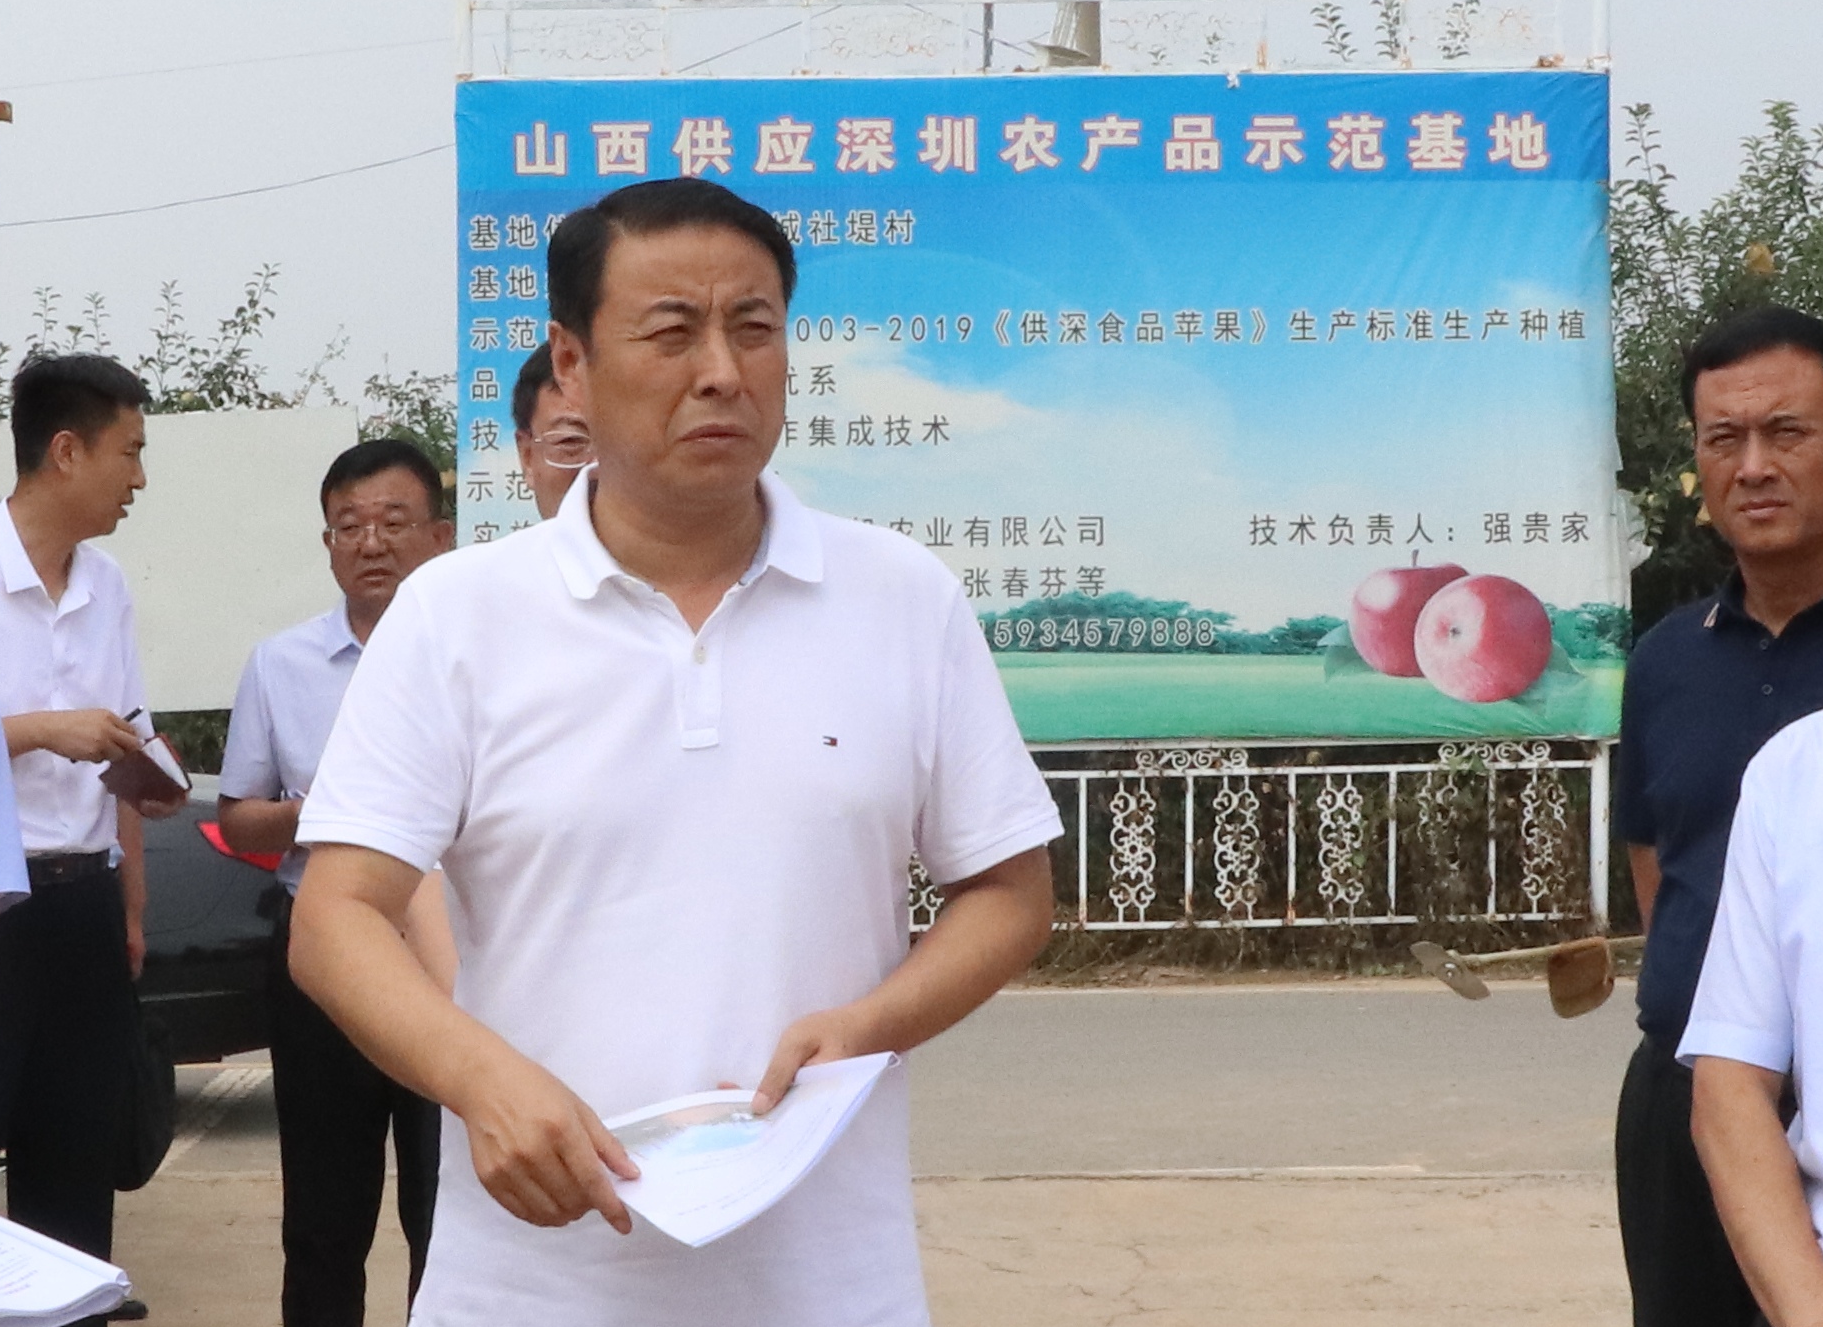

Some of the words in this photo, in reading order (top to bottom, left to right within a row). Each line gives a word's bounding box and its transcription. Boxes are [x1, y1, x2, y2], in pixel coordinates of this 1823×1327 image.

[514, 112, 1551, 175] 山西供应深圳农产品示范基地
[469, 265, 550, 302] 基地
[470, 318, 550, 351] 示范
[470, 368, 500, 402] 品
[471, 419, 500, 451] 技
[853, 515, 1107, 548] 业有限公司
[963, 564, 1107, 599] 张春芬等
